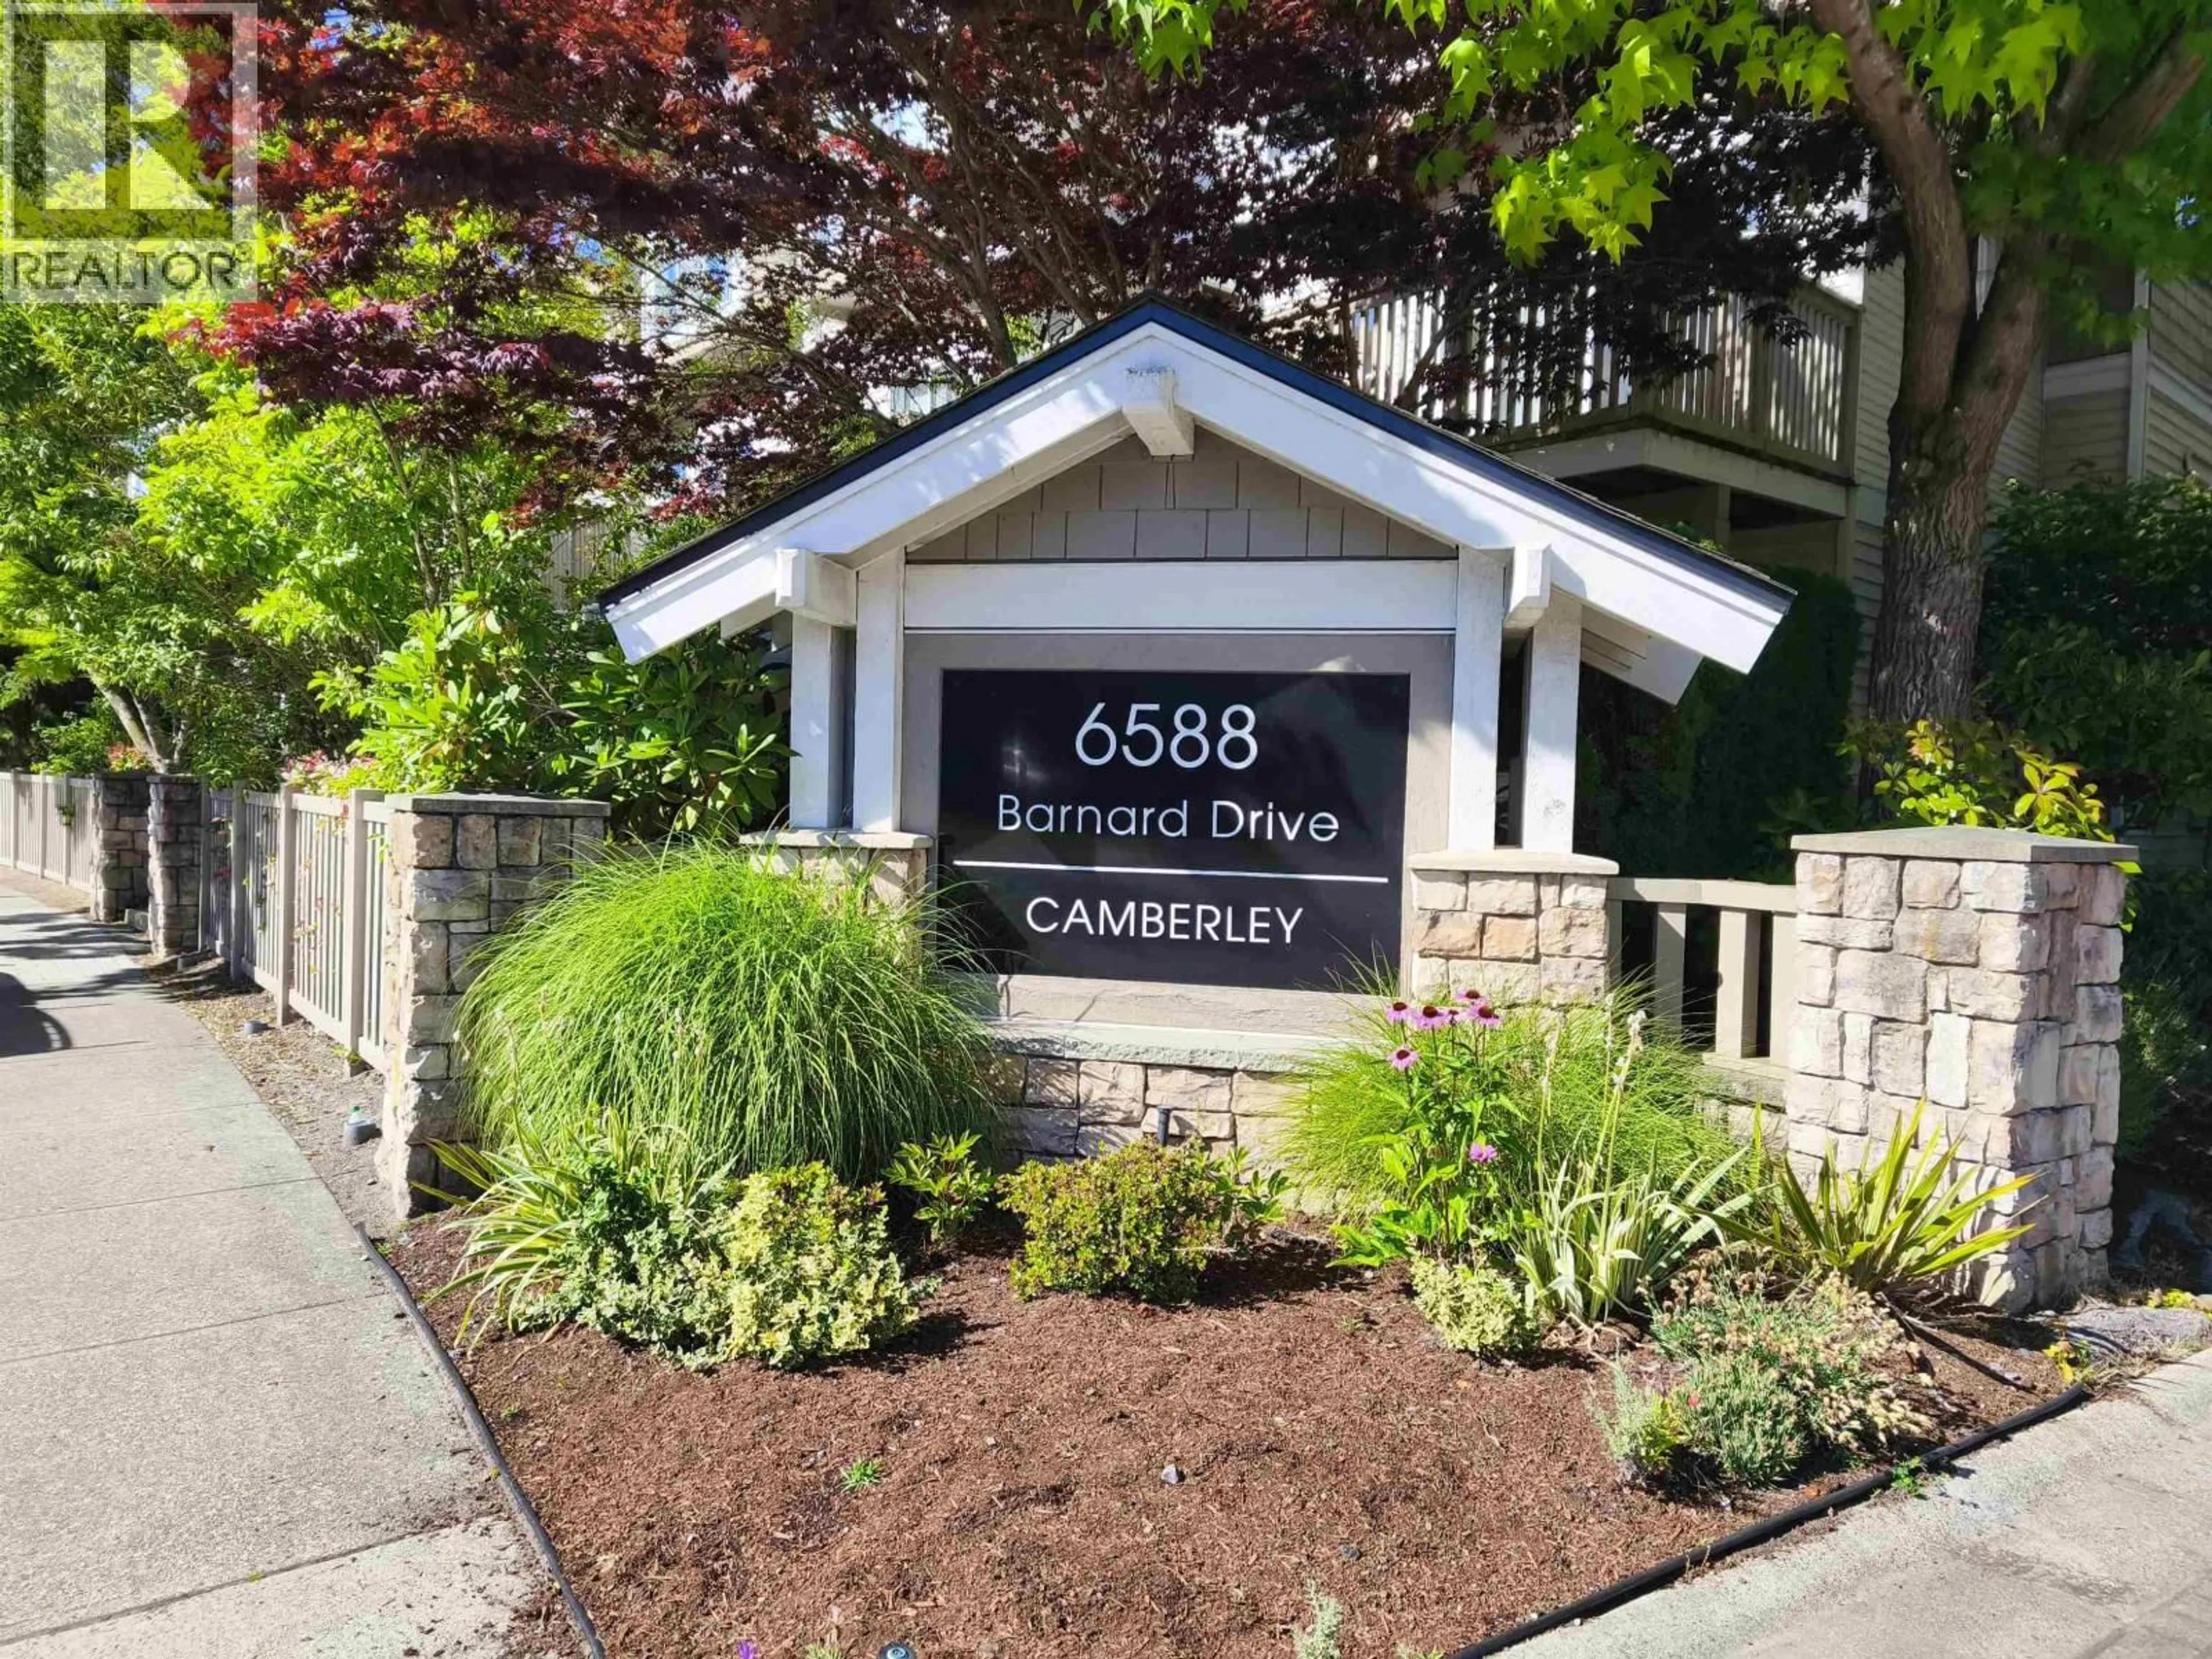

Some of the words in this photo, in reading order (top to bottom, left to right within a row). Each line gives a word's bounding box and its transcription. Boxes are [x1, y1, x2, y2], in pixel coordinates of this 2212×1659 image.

[1075, 702, 1258, 770] 6588
[998, 794, 1188, 838] Barnard
[1211, 800, 1340, 842] Drive
[1025, 896, 1304, 944] CAMBERLEY
